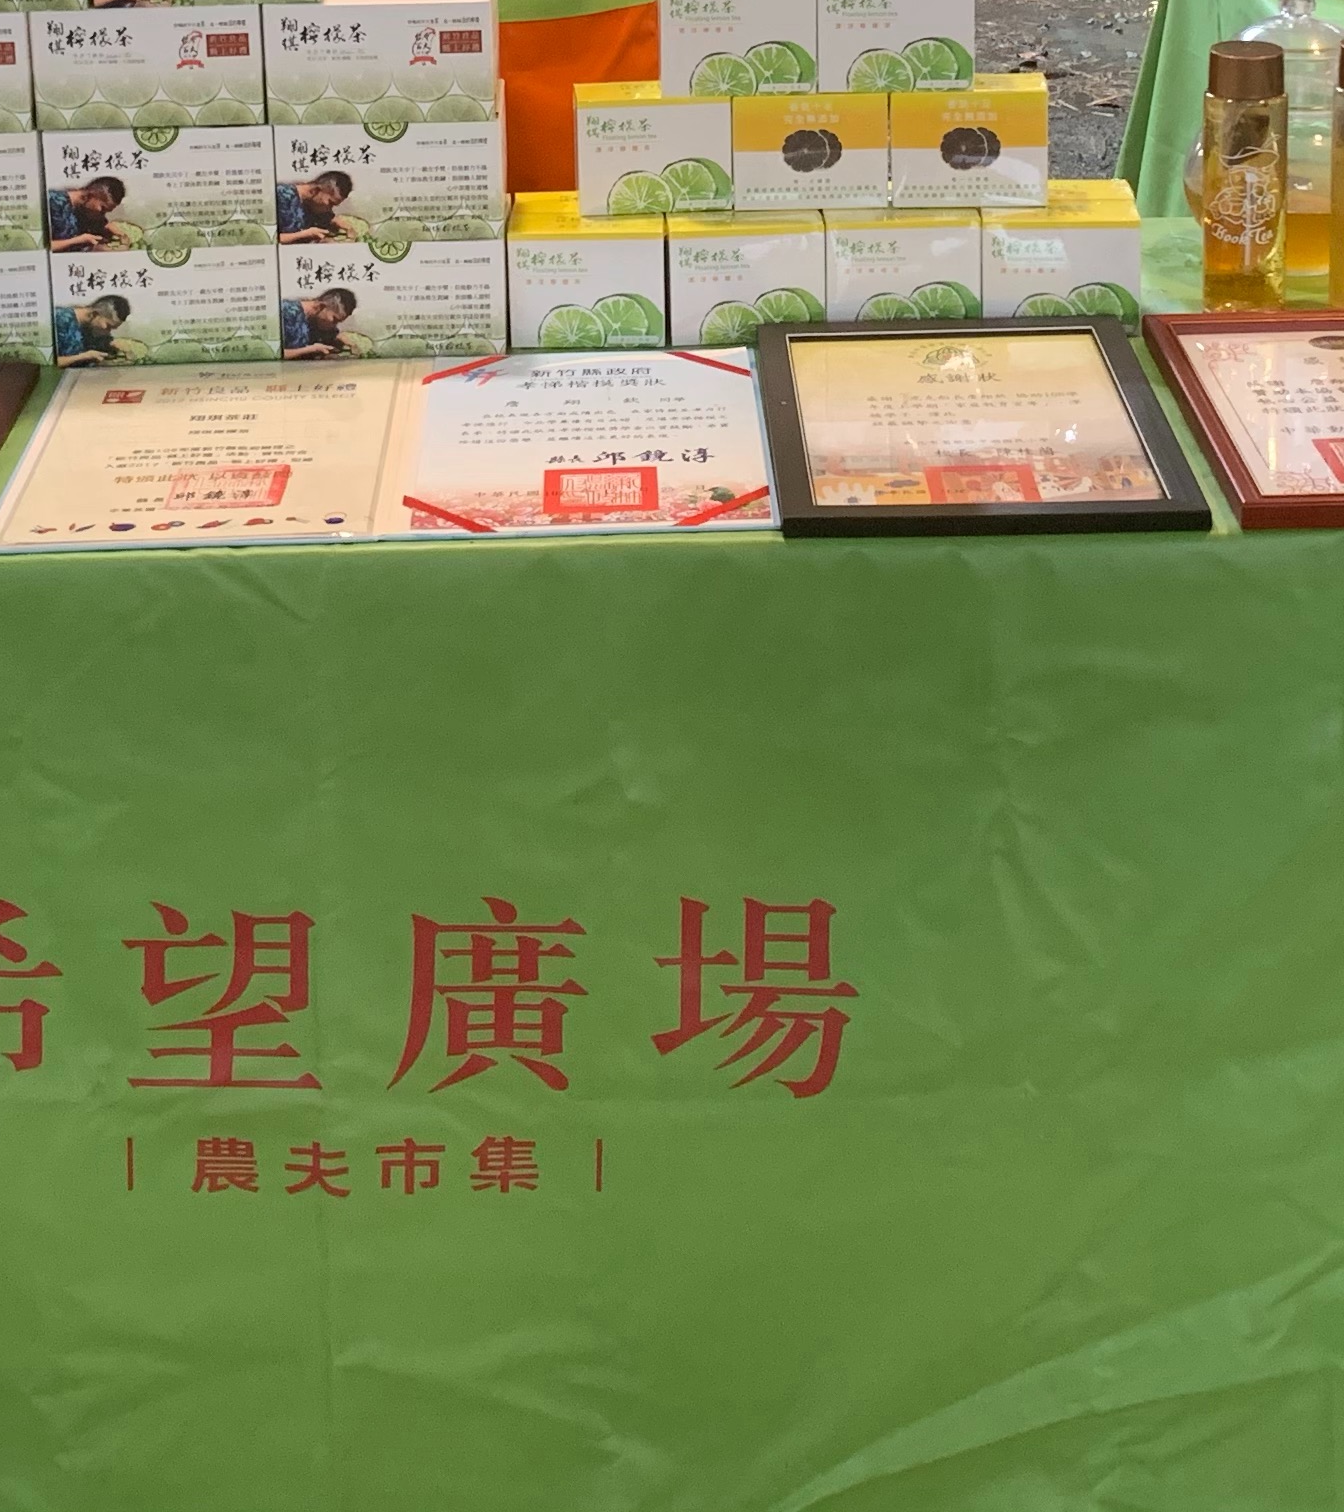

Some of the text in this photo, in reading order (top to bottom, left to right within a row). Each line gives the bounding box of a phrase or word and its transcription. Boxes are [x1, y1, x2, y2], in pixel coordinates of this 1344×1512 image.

[531, 367, 652, 378] 新竹縣政府
[916, 372, 1003, 384] 感謝狀
[190, 1135, 541, 1198] 農夫市集
